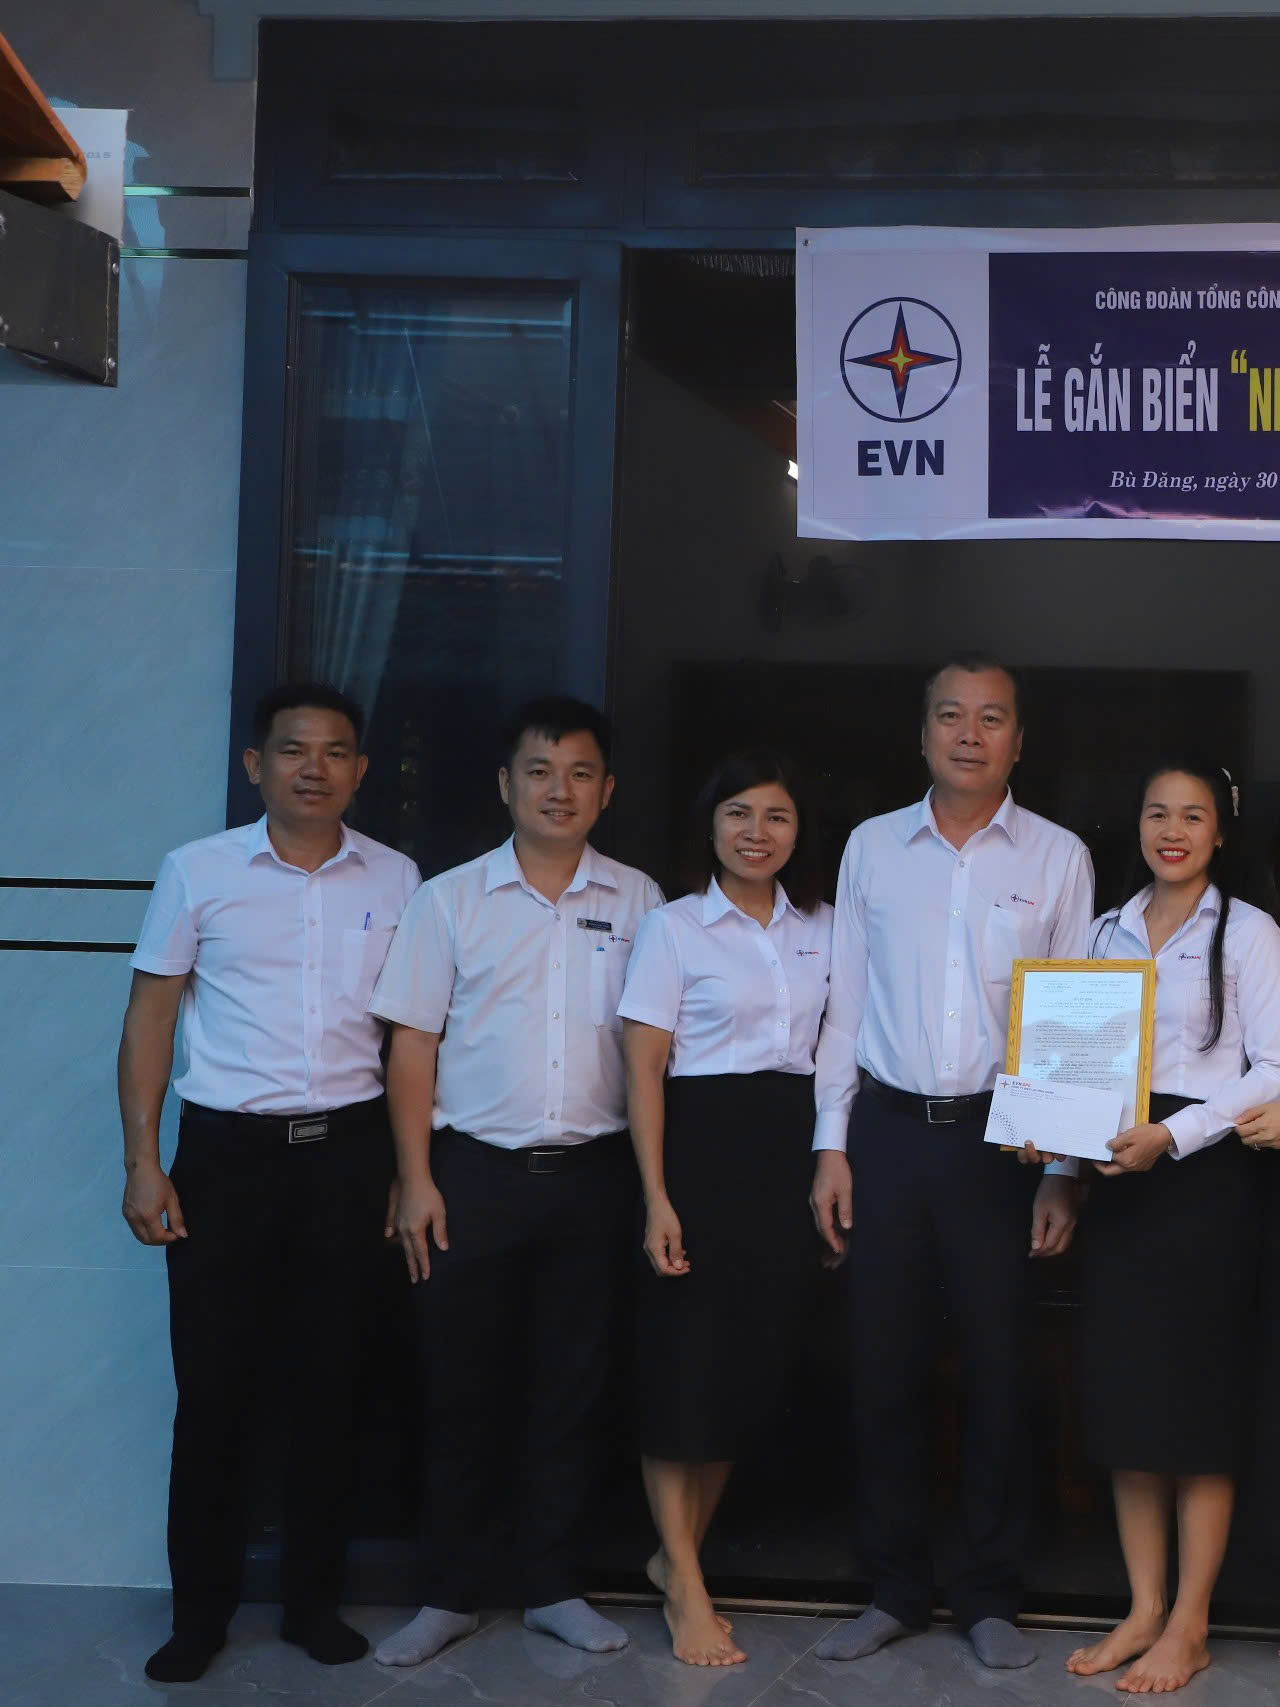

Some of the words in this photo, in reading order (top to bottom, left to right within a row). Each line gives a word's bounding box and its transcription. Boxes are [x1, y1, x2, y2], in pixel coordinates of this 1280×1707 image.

[1095, 287, 1141, 310] CÔNG
[1146, 286, 1192, 310] ĐOÀN
[1197, 283, 1241, 309] TỔNG
[1016, 343, 1052, 432] LỄ
[1064, 342, 1131, 433] GẮN
[1142, 339, 1219, 432] BIỂN
[857, 439, 945, 477] EVN
[1109, 470, 1136, 488] Bù
[1141, 470, 1198, 492] Đăng,
[1203, 471, 1251, 492] ngày
[1255, 471, 1278, 489] 30
